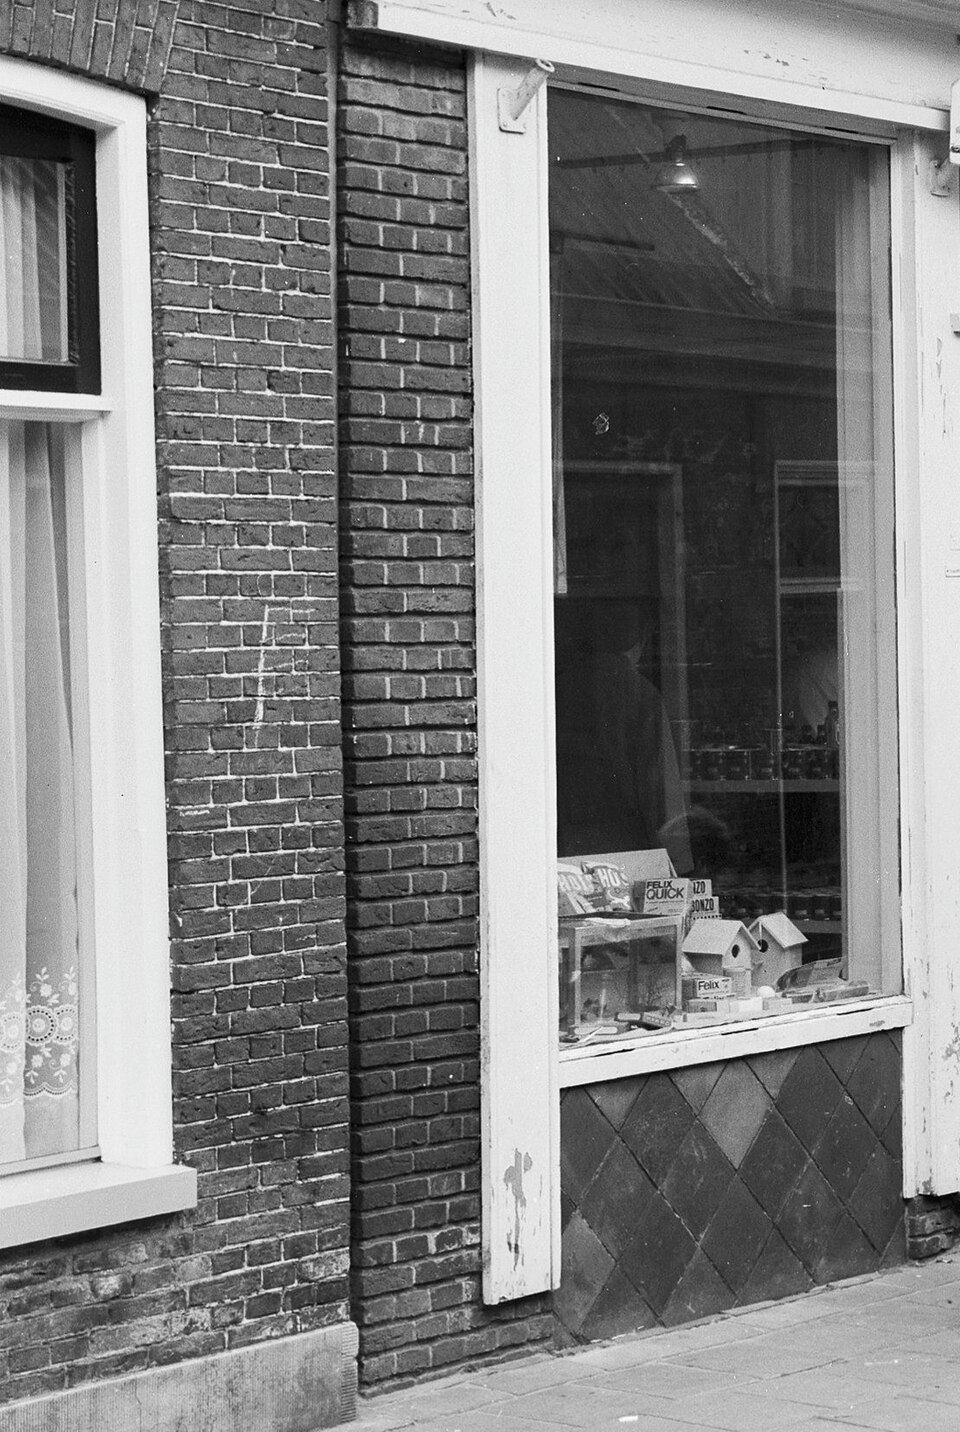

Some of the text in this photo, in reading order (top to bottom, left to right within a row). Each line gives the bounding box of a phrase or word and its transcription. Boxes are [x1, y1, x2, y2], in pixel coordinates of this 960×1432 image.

[646, 880, 673, 889] FELIX
[646, 887, 685, 900] QUICK
[698, 980, 720, 991] Felix
